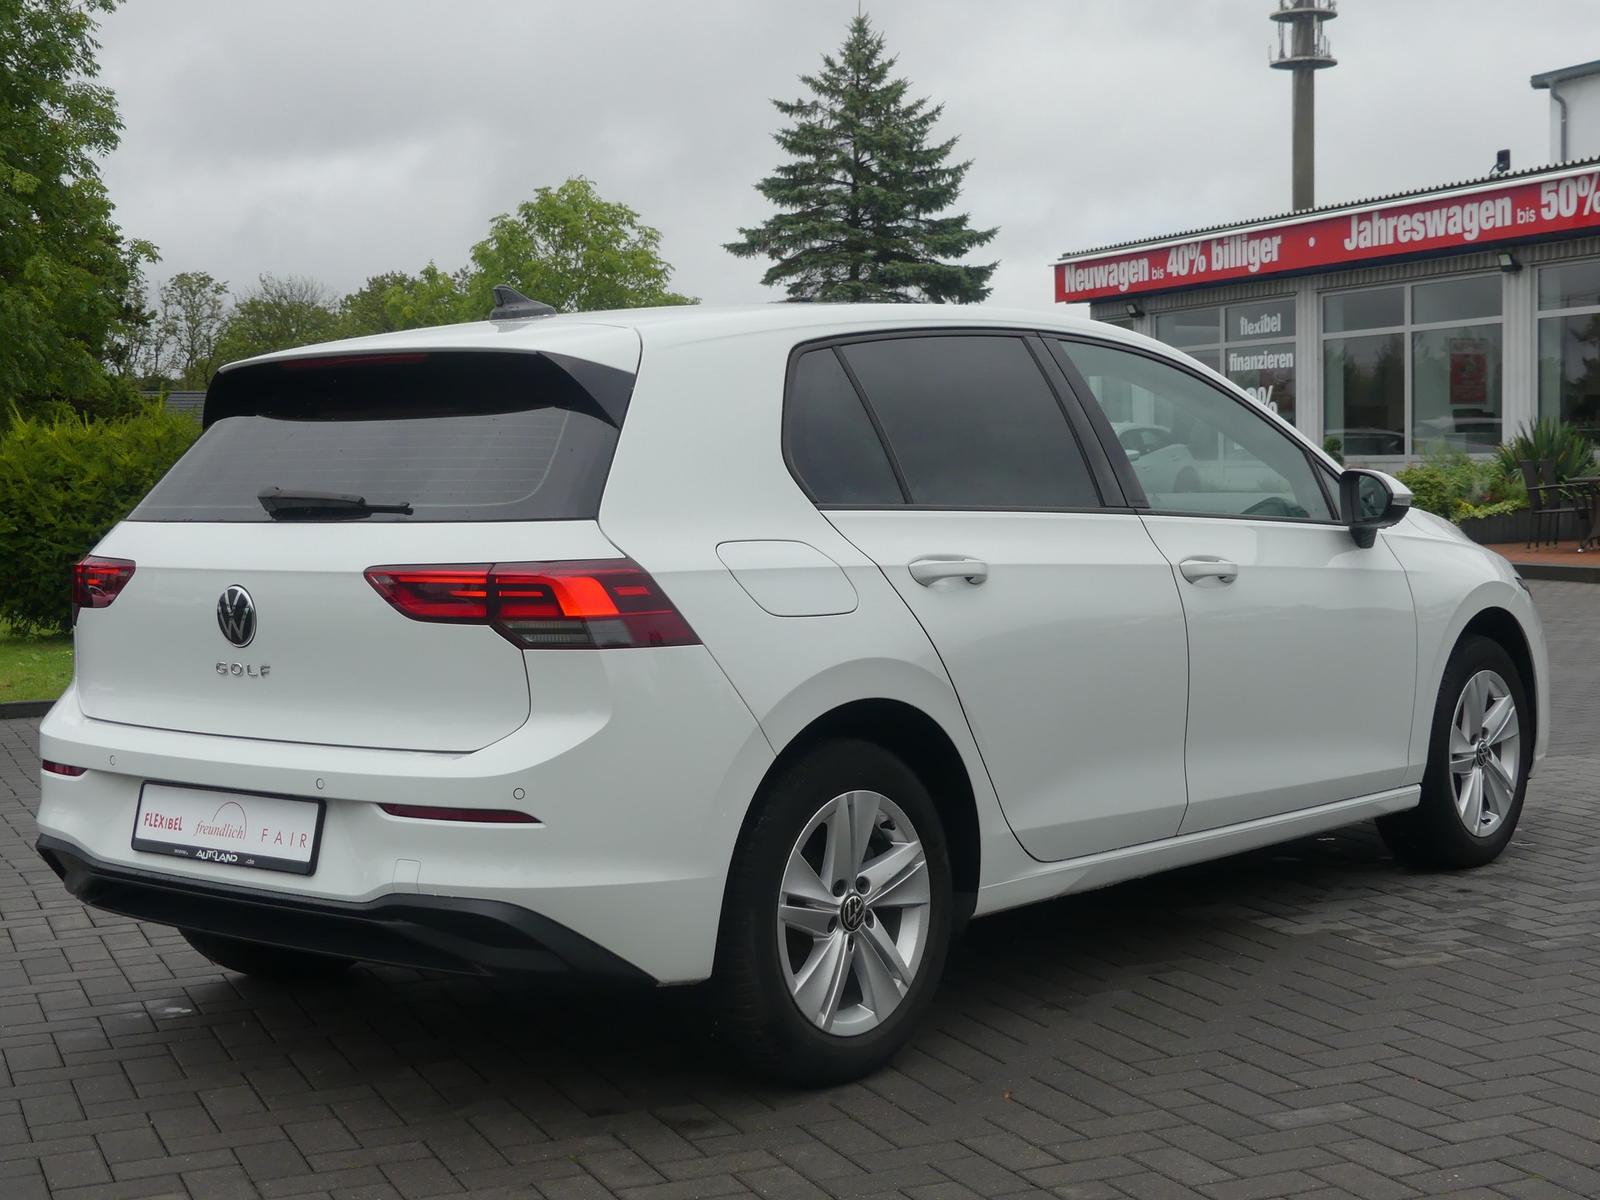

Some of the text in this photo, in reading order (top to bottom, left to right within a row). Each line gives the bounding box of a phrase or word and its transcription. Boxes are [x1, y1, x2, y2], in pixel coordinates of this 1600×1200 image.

[1343, 197, 1512, 251] Jahreswagen
[1516, 207, 1537, 225] bis
[1064, 233, 1282, 293] Neuwagen bis 40% billiger
[1240, 312, 1282, 336] flexibel
[1229, 350, 1295, 372] finanzieren
[215, 661, 271, 678] GOLF
[194, 819, 244, 840] freundlich
[260, 827, 307, 849] FAIR
[196, 849, 239, 863] AUTOLAND
